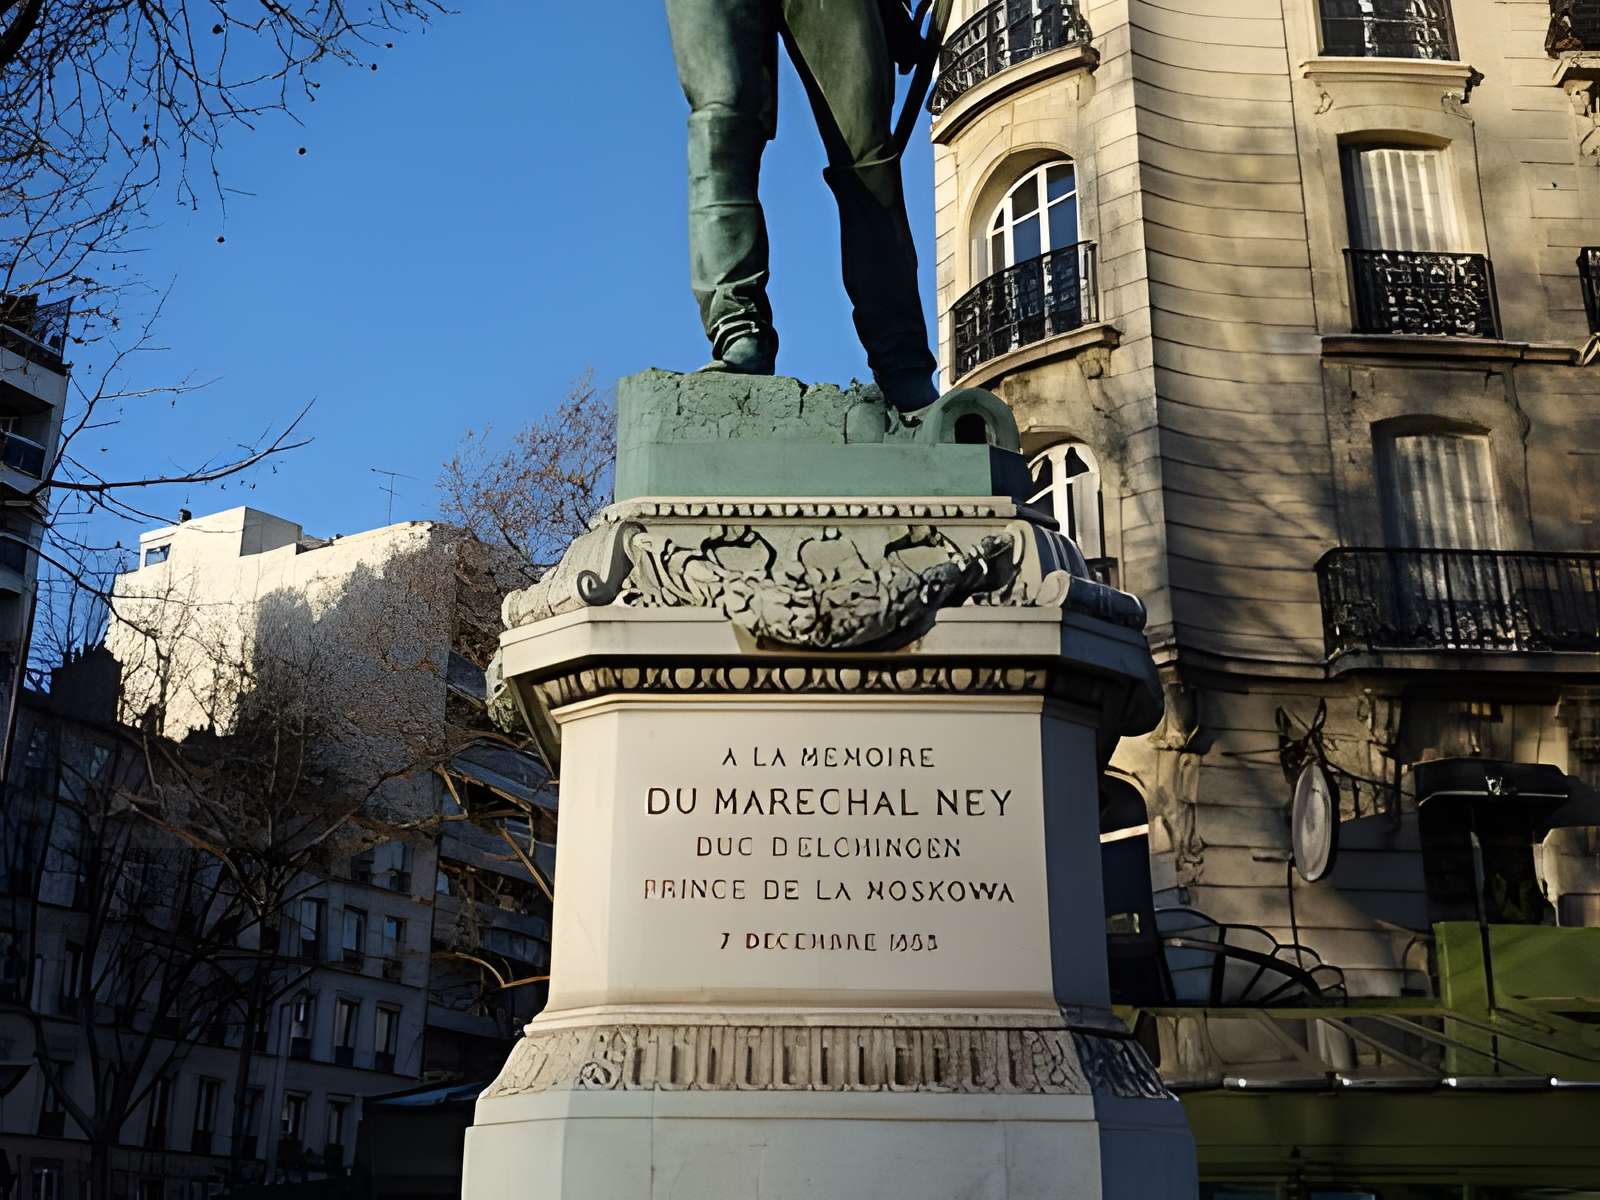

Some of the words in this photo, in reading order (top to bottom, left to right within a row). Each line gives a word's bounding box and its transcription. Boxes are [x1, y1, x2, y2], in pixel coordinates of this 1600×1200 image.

[721, 746, 739, 768] A
[753, 745, 787, 768] LA
[800, 746, 936, 768] MEMOIRE
[647, 787, 697, 816] DU
[714, 787, 920, 817] MARECHAL
[936, 788, 1012, 817] NEY
[696, 836, 753, 857] DUC
[644, 878, 747, 901] PRINCE
[763, 879, 800, 901] DE
[816, 879, 852, 902] LA
[866, 879, 1015, 904] MOSKOWA
[720, 932, 731, 951] 7
